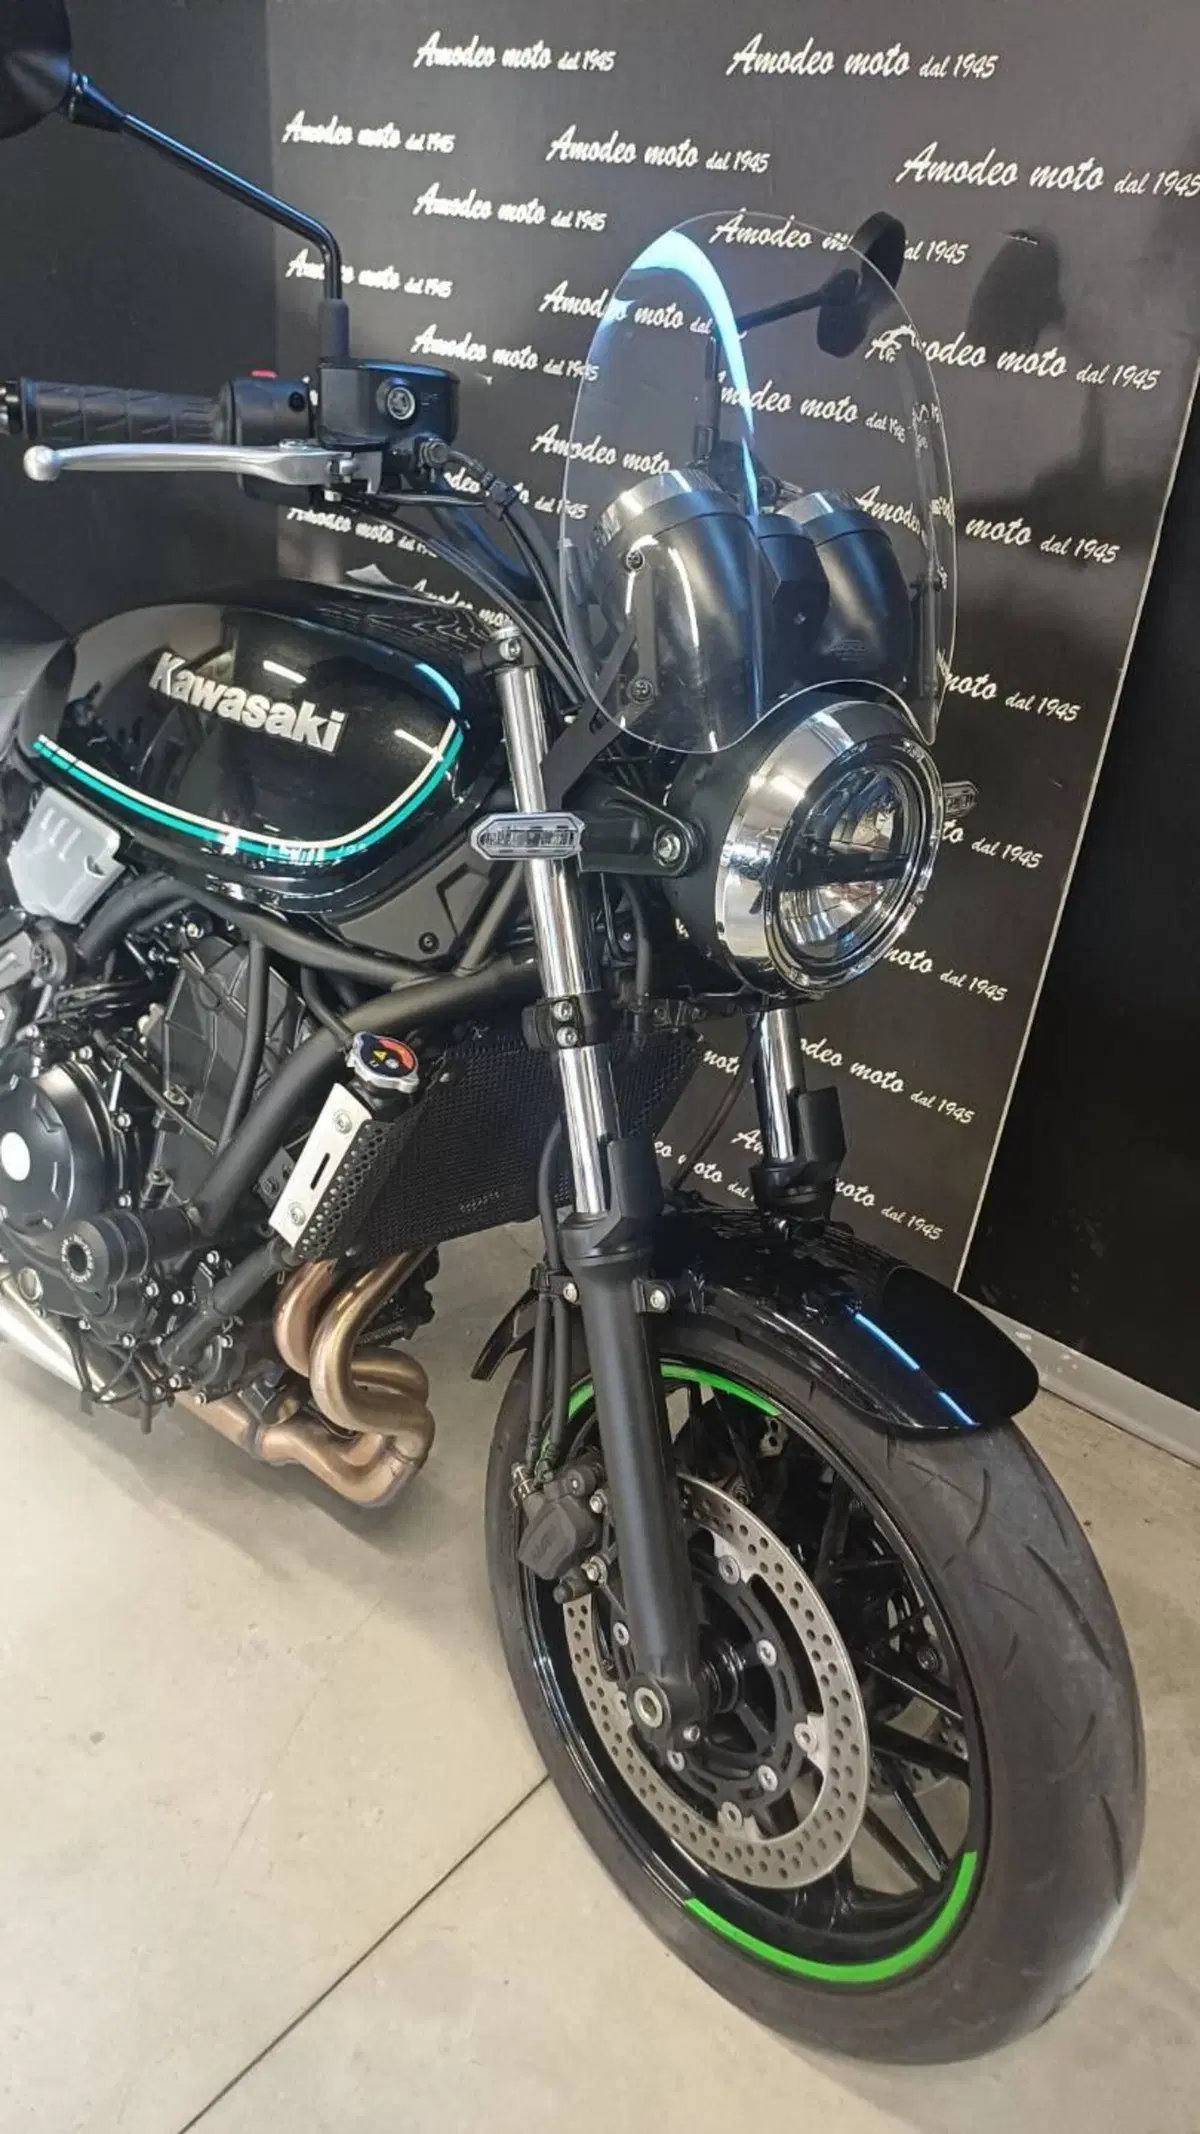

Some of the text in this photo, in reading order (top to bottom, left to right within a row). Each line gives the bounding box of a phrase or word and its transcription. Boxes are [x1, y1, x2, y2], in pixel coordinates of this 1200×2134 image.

[413, 30, 617, 72] Amodeo moto dal 1945
[726, 33, 999, 79] Amodeo moto dal 1945
[282, 110, 456, 153] Amodeo moto dal 1945
[546, 124, 770, 173] Amodeo moto dal 1945
[895, 141, 1200, 197] Amodeo moto dal 1945
[412, 182, 608, 232] Amodeo moto dal 1945
[708, 207, 813, 250] Amodeo
[926, 240, 970, 265] 1945
[358, 266, 400, 293] moto
[425, 278, 454, 299] 1945
[634, 301, 684, 329] moto
[411, 324, 487, 362] Amodeo
[493, 344, 539, 370] moto
[997, 347, 1067, 377] moto
[1076, 363, 1109, 385] dal
[1112, 365, 1161, 391] 1945
[800, 395, 859, 422] moto
[866, 410, 889, 431] dal
[531, 423, 670, 475] Amodeo moto
[535, 496, 556, 515] dal
[965, 518, 1032, 547] moto
[1040, 534, 1069, 555] dal
[1070, 539, 1121, 564] 1945
[148, 652, 346, 753] Kawasaki
[1004, 691, 1034, 713] dal
[1036, 698, 1081, 722] 1945
[971, 838, 997, 857] dal
[1002, 839, 1044, 869] 1945
[940, 969, 965, 989] dal
[968, 975, 1009, 1003] 1945
[849, 1059, 904, 1095] moto
[910, 1089, 934, 1110] dal
[937, 1098, 975, 1126] 1945
[728, 1180, 748, 1200] dal
[881, 1205, 906, 1226] dal
[907, 1212, 945, 1242] 1945
